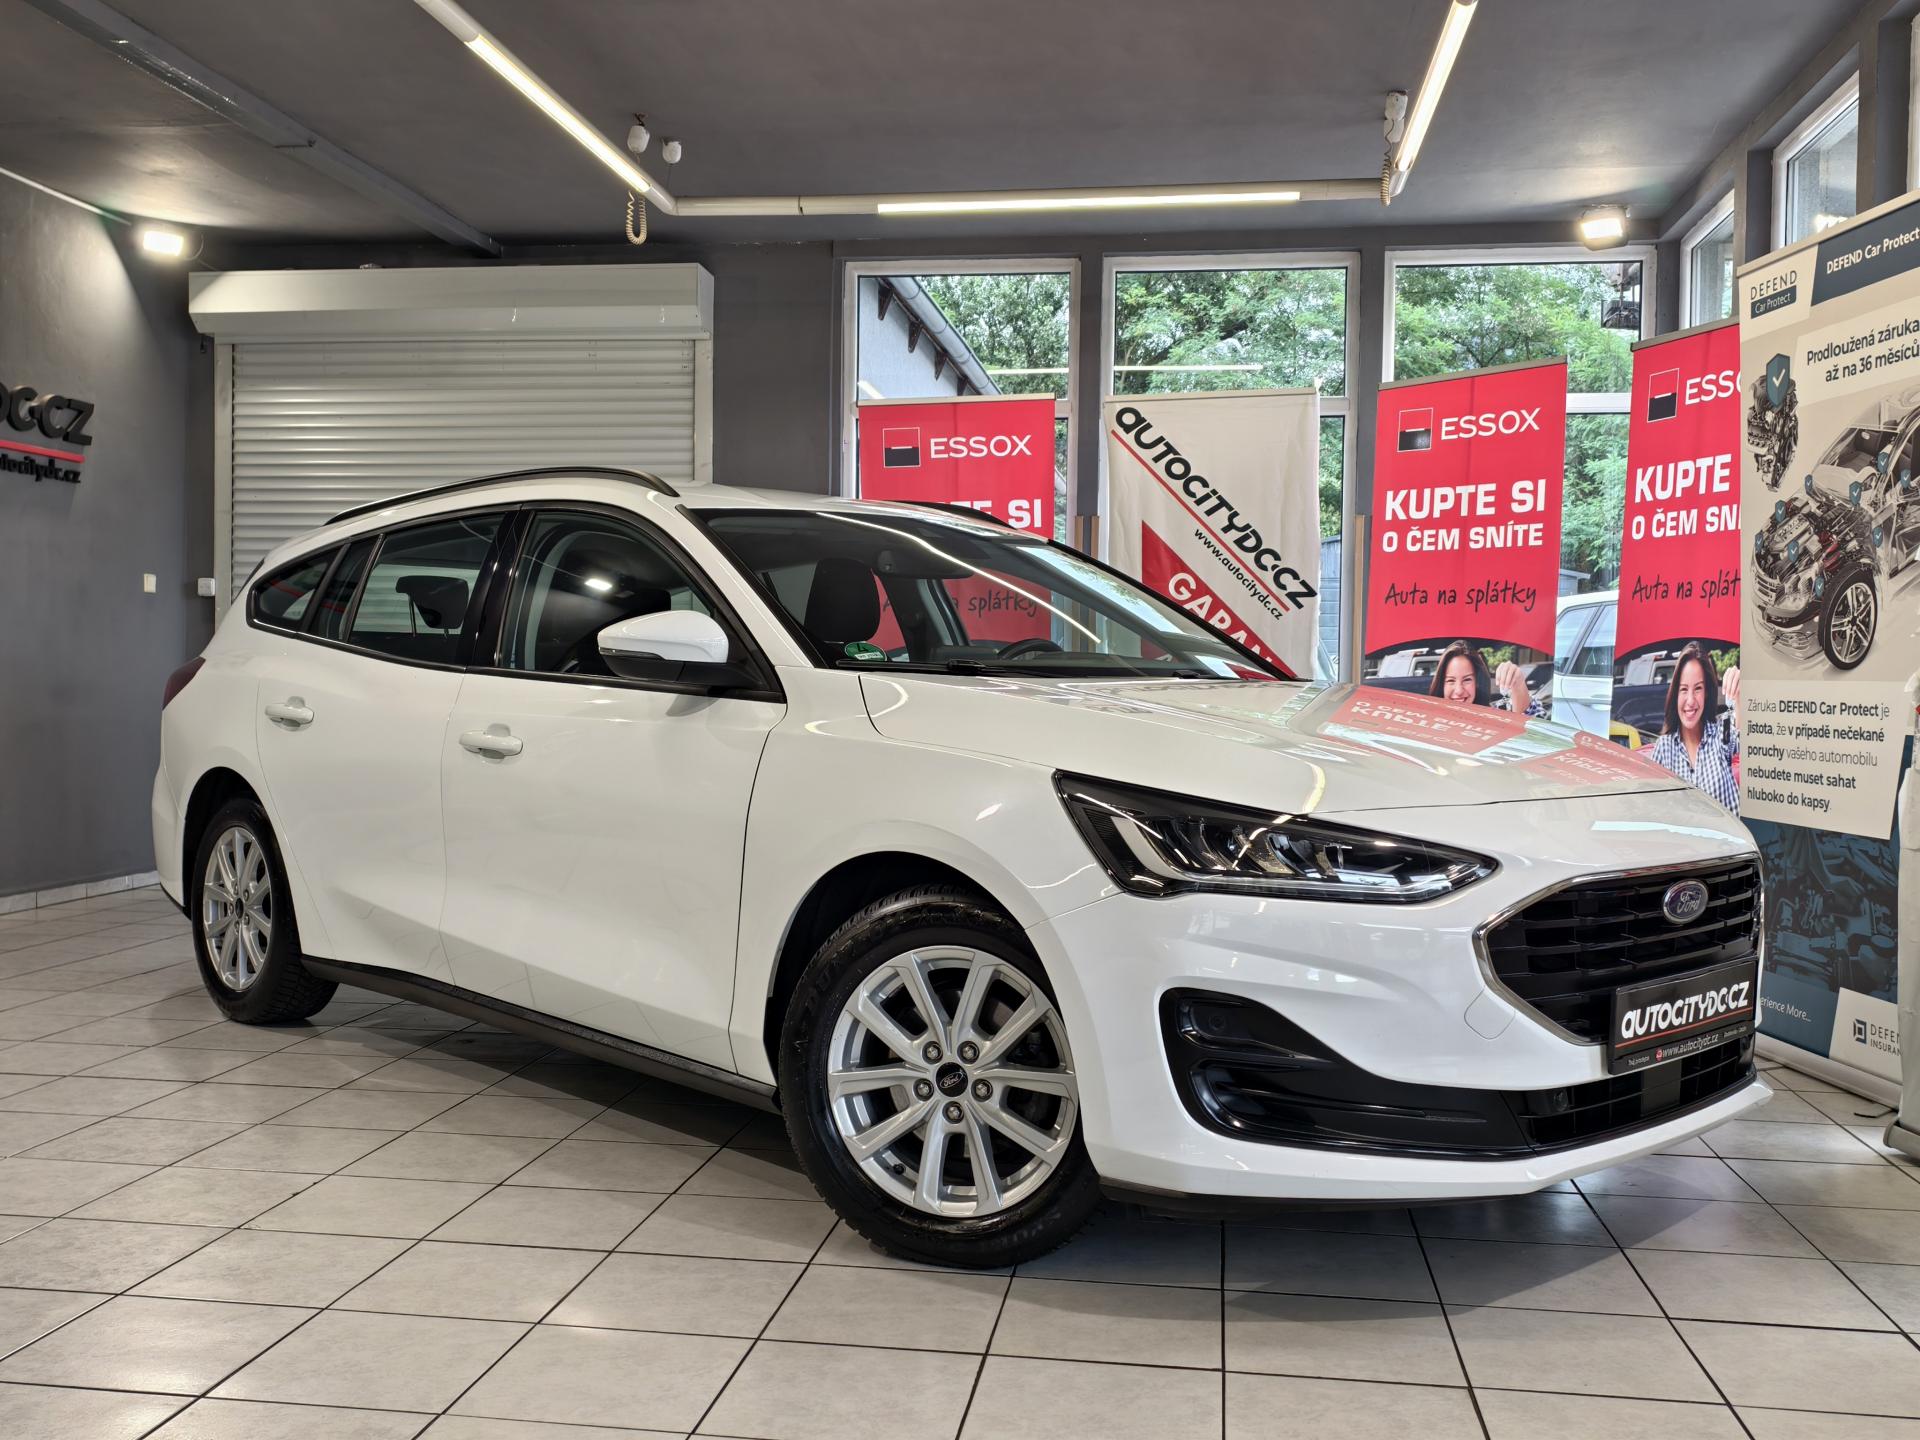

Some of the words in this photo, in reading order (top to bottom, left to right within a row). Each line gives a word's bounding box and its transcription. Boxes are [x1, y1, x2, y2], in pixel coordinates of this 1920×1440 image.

[1827, 249, 1863, 275] DEFEND
[1864, 244, 1881, 259] Car
[1882, 227, 1920, 252] Protect
[1750, 270, 1798, 300] DEFEND
[1754, 301, 1767, 314] Car
[1766, 292, 1791, 310] Protect
[1807, 328, 1875, 366] Prodloužená
[1877, 318, 1920, 344] záruka
[1825, 364, 1839, 382] až
[1842, 363, 1858, 378] na
[1859, 355, 1872, 373] 36
[1875, 338, 1920, 369] měsíců
[1685, 369, 1741, 405] ESS
[1441, 408, 1541, 440] ESSOX
[930, 435, 1032, 459] ESSOX
[1634, 453, 1732, 504] KUPTE
[1007, 498, 1042, 529] SI
[1385, 483, 1497, 521] KUPTE
[1511, 478, 1547, 513] SI
[1382, 530, 1398, 553] O
[1406, 526, 1459, 552] ČEM
[1469, 520, 1544, 549] SNÍTE
[1631, 515, 1645, 541] O
[1652, 507, 1698, 538] ČEM
[1194, 528, 1284, 620] www.autocitydc.cz
[1631, 575, 1669, 601] Auta
[1676, 584, 1693, 599] na
[968, 590, 1038, 617] splátky
[1384, 583, 1429, 607] Auta
[1437, 589, 1457, 605] na
[1465, 579, 1537, 613] splátky
[1168, 572, 1273, 663] GARA
[1747, 698, 1777, 713] Záruka
[1779, 700, 1817, 714] DEFEND
[1819, 701, 1837, 715] Car
[1840, 702, 1879, 717] Protect
[1879, 702, 1890, 721] je
[1747, 720, 1774, 736] jistota,
[1776, 721, 1787, 736] že
[1788, 726, 1795, 736] v
[1795, 722, 1831, 740] případě
[1833, 724, 1885, 742] nečekané
[1747, 744, 1785, 761] poruchy
[1785, 746, 1817, 761] vašeho
[1819, 750, 1878, 767] automobilu
[1747, 766, 1792, 782] nebudete
[1793, 771, 1824, 786] muset
[1826, 774, 1856, 789] sahat
[1747, 787, 1785, 803] hluboko
[1787, 791, 1800, 805] do
[1801, 793, 1832, 813] kapsy.
[1676, 890, 1702, 914] Ford
[943, 1074, 959, 1087] Ford
